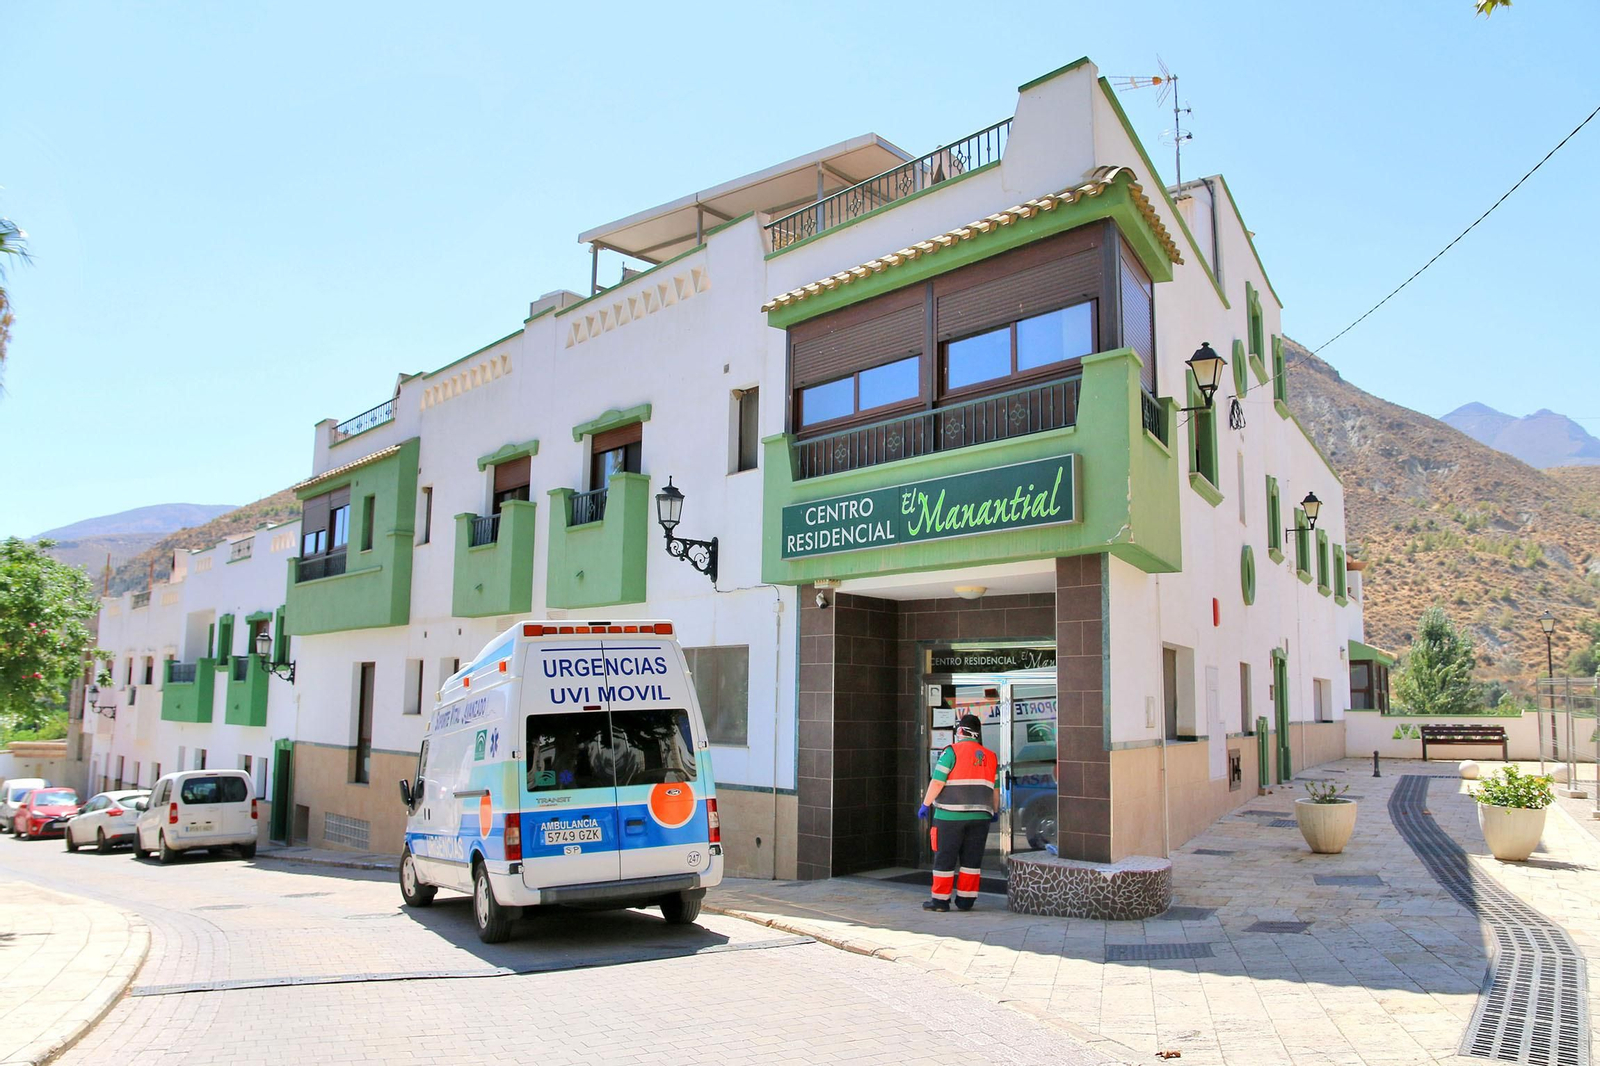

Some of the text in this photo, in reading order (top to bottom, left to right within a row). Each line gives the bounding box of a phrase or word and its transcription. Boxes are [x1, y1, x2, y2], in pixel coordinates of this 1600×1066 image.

[901, 466, 1064, 536] El Manantial
[805, 497, 874, 526] CENTRO
[787, 520, 895, 553] RESIDENCIAL
[542, 656, 668, 678] URGENCIAS
[931, 655, 1017, 666] CENTRO RESIDENCIAL
[550, 684, 671, 704] UVI MOVIL
[536, 796, 572, 804] TRANSIT
[540, 818, 599, 831] AMBULANCIA
[547, 829, 600, 843] 5749 GZK
[688, 852, 701, 864] 247
